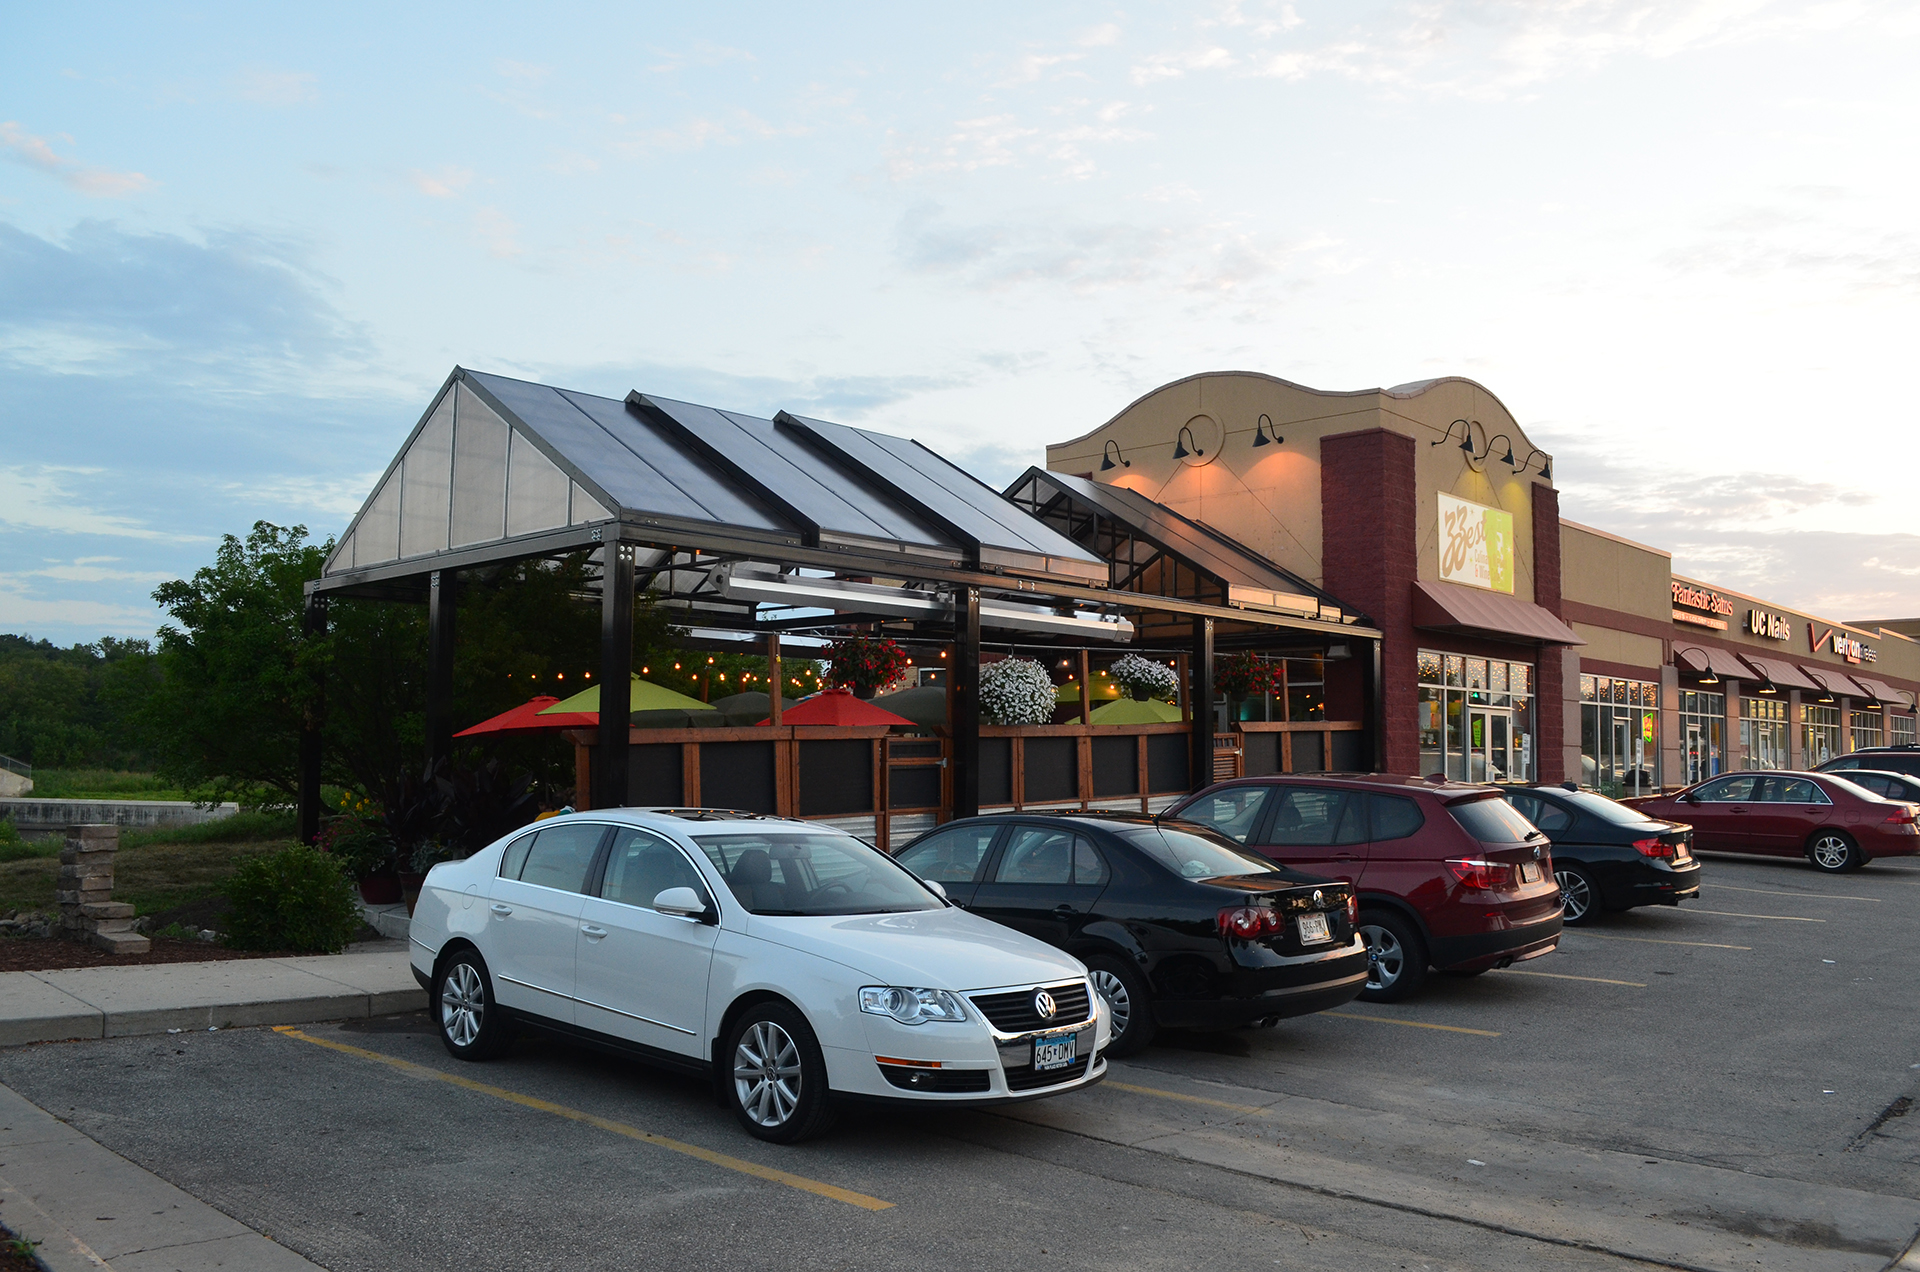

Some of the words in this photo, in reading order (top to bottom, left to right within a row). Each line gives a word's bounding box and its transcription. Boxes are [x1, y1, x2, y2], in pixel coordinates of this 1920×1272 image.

[1671, 581, 1710, 611] Fantastic
[1711, 592, 1733, 616] Sams
[1751, 609, 1766, 636] UC
[1767, 613, 1790, 641] Nails
[1832, 632, 1861, 664] verizon
[1036, 1045, 1052, 1064] 645
[1058, 1041, 1074, 1060] DMV
